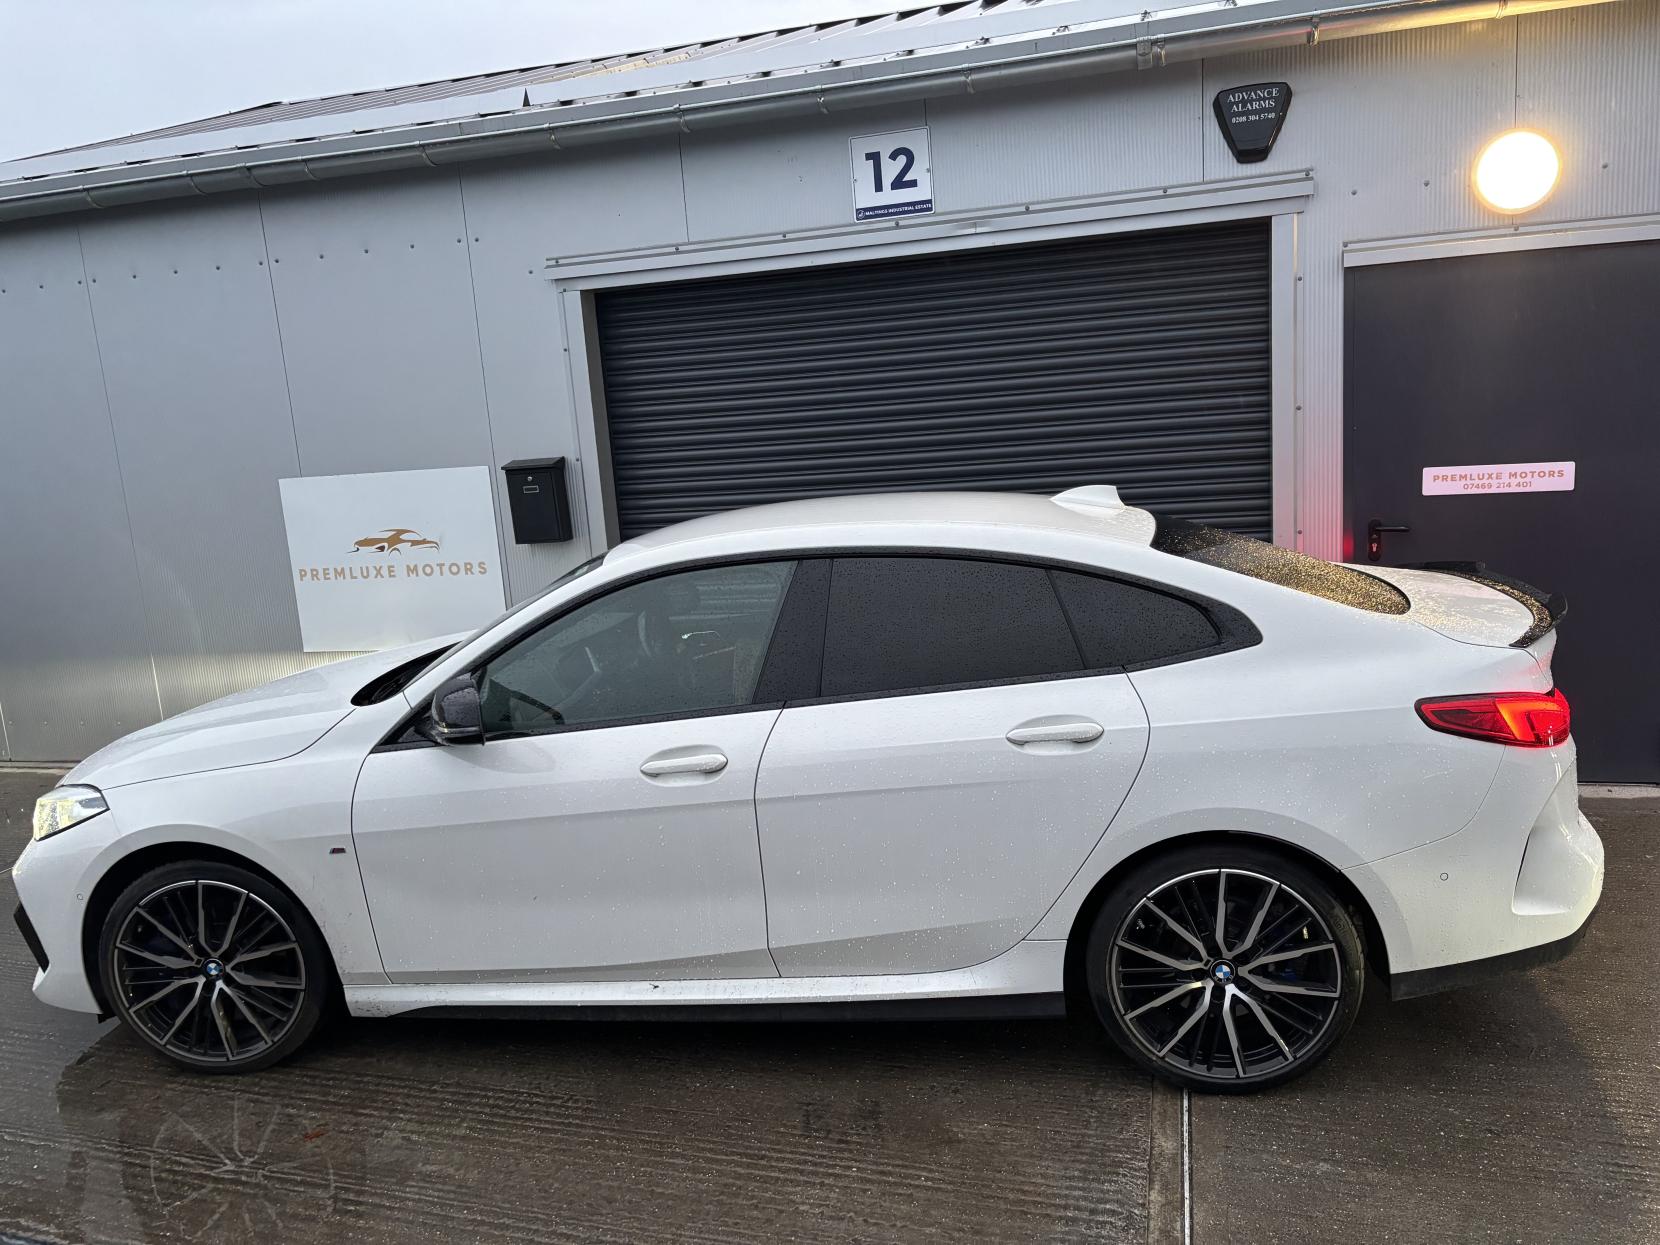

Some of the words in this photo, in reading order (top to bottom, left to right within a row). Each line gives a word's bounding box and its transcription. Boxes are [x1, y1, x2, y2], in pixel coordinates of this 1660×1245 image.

[1227, 88, 1280, 103] ADVANCE
[1231, 99, 1275, 113] ALARMS
[864, 146, 918, 193] 12
[888, 205, 915, 213] INDUSTRIAL
[1432, 472, 1503, 483] PREMLUXE
[1508, 469, 1565, 480] MOTORS
[1515, 480, 1532, 488] 401
[299, 565, 397, 582] PREMLUXE
[406, 561, 488, 578] MOTORS
